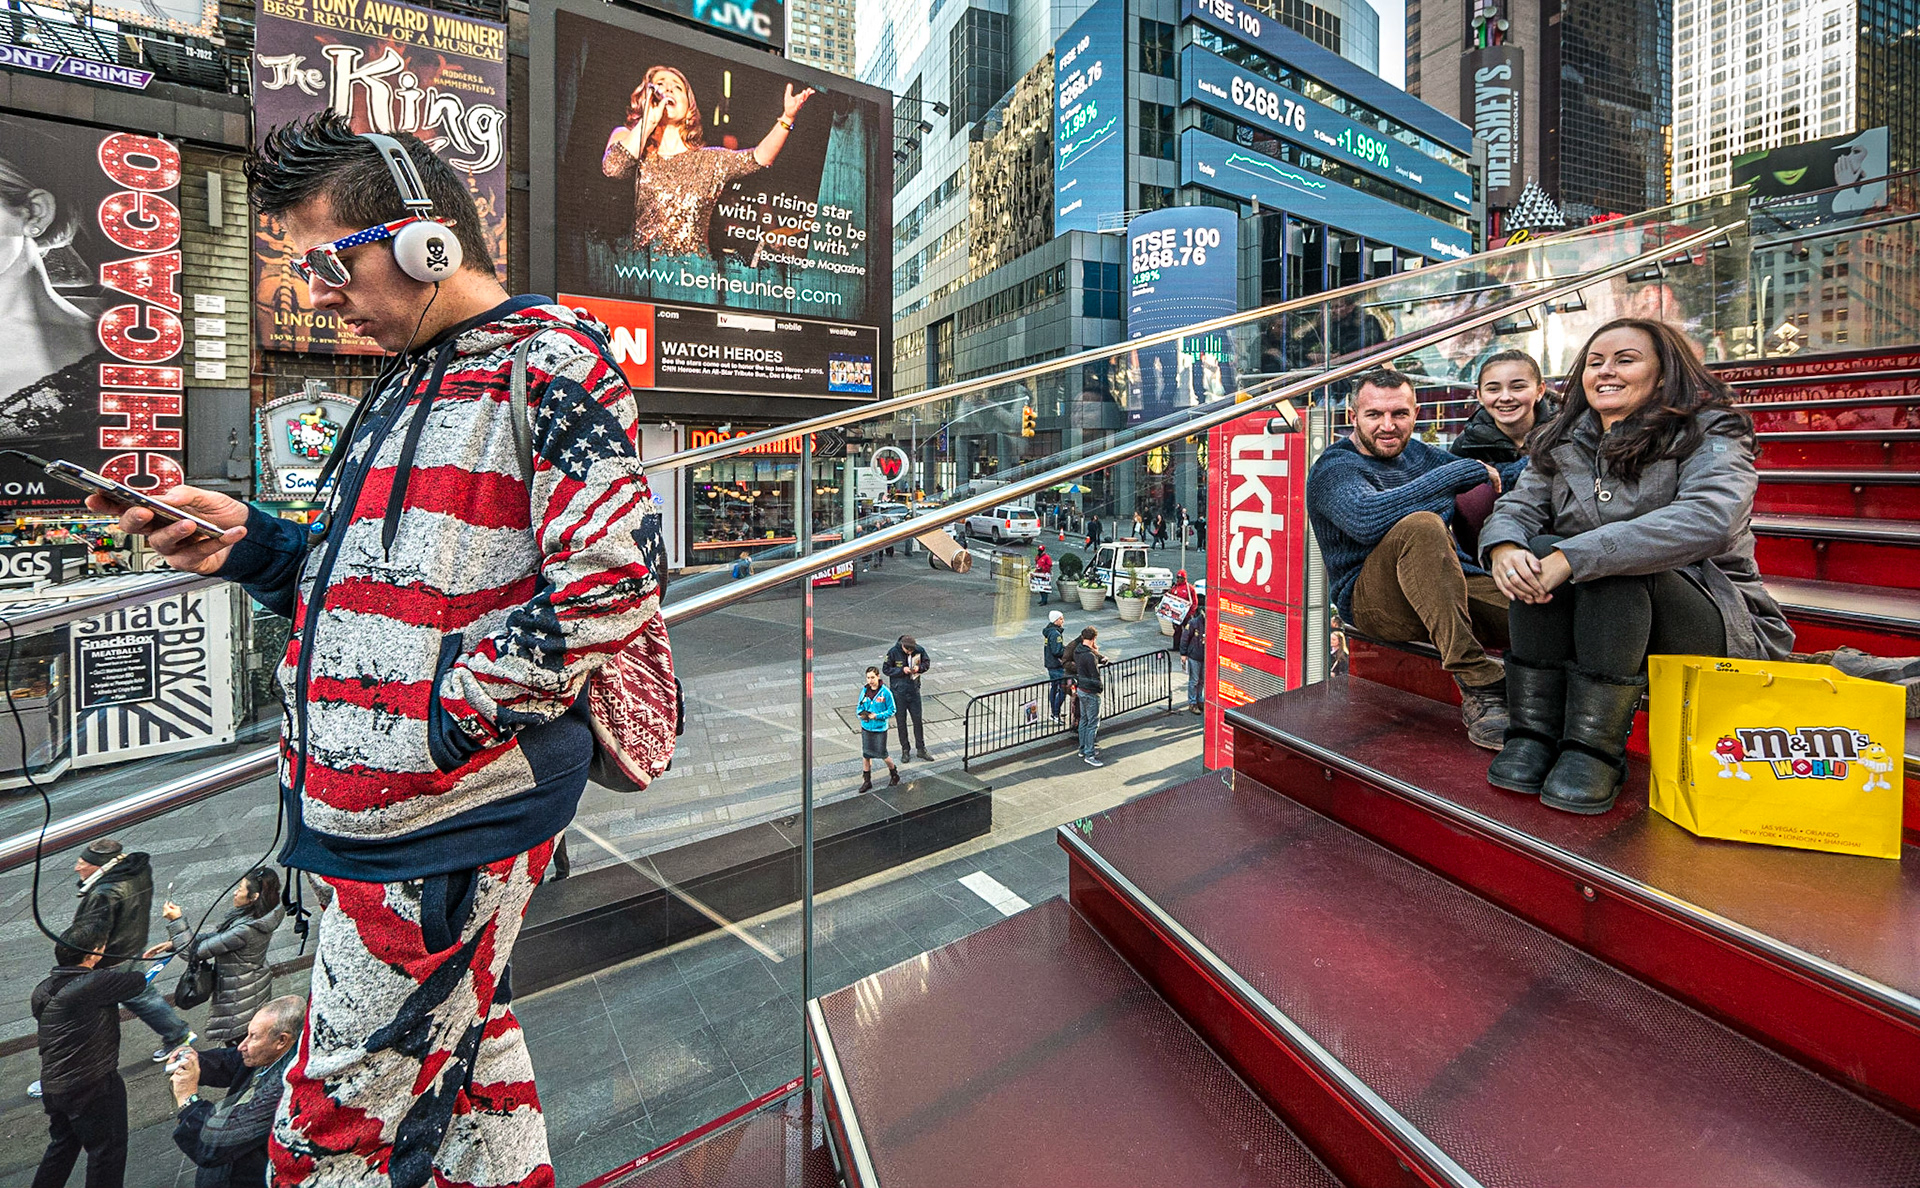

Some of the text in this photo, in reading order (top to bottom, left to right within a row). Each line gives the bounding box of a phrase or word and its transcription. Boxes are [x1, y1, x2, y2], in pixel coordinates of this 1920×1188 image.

[263, 0, 503, 61] BEST REVIVAL OF A MUSICAL
[364, 1, 428, 32] AWARD
[433, 15, 504, 49] WINNER!
[713, 3, 772, 37] JVC
[1237, 11, 1260, 38] 100
[1059, 35, 1090, 72] FTSE 100
[69, 60, 143, 86] PRIME
[256, 53, 326, 97] The
[433, 78, 496, 95] HAMMERSTEIN'S
[442, 69, 477, 82] RODGERS
[1059, 61, 1102, 109] 6268.76
[322, 44, 507, 174] King
[1059, 100, 1098, 142] +1.99%
[1231, 76, 1306, 132] 6268.76
[1337, 128, 1390, 169] +1.99%
[1474, 64, 1512, 187] HERSHEY'S
[1198, 162, 1216, 178] Today
[772, 192, 818, 218] rising
[822, 203, 853, 221] star
[718, 203, 867, 241] with a voice to be
[727, 225, 810, 250] reckoned
[1132, 227, 1220, 256] FTSE 100
[817, 259, 866, 277] Magazine
[1132, 246, 1207, 274] 6268.76
[614, 264, 842, 306] www.betheunice.com
[97, 131, 184, 496] CHICAGO
[274, 311, 349, 330] LINCOLN
[657, 310, 680, 319] .com
[777, 322, 802, 332] mobile
[829, 327, 857, 337] weather
[661, 340, 783, 364] WATCH HEROES
[675, 358, 685, 366] the
[686, 359, 701, 367] stars
[712, 368, 734, 376] All-Star
[879, 456, 903, 476] W
[1221, 480, 1229, 509] Theatre
[1229, 426, 1288, 586] tkts
[1221, 511, 1229, 560] Development
[80, 635, 155, 649] SnackBox
[91, 646, 144, 658] MEATBALLS
[158, 627, 206, 690] BOX
[1775, 826, 1798, 834] VEGAS
[1805, 829, 1840, 838] ORLANDO
[1783, 834, 1816, 843] LONDON
[1823, 838, 1862, 848] SHANGHAI
[635, 1155, 649, 1168] tkts
